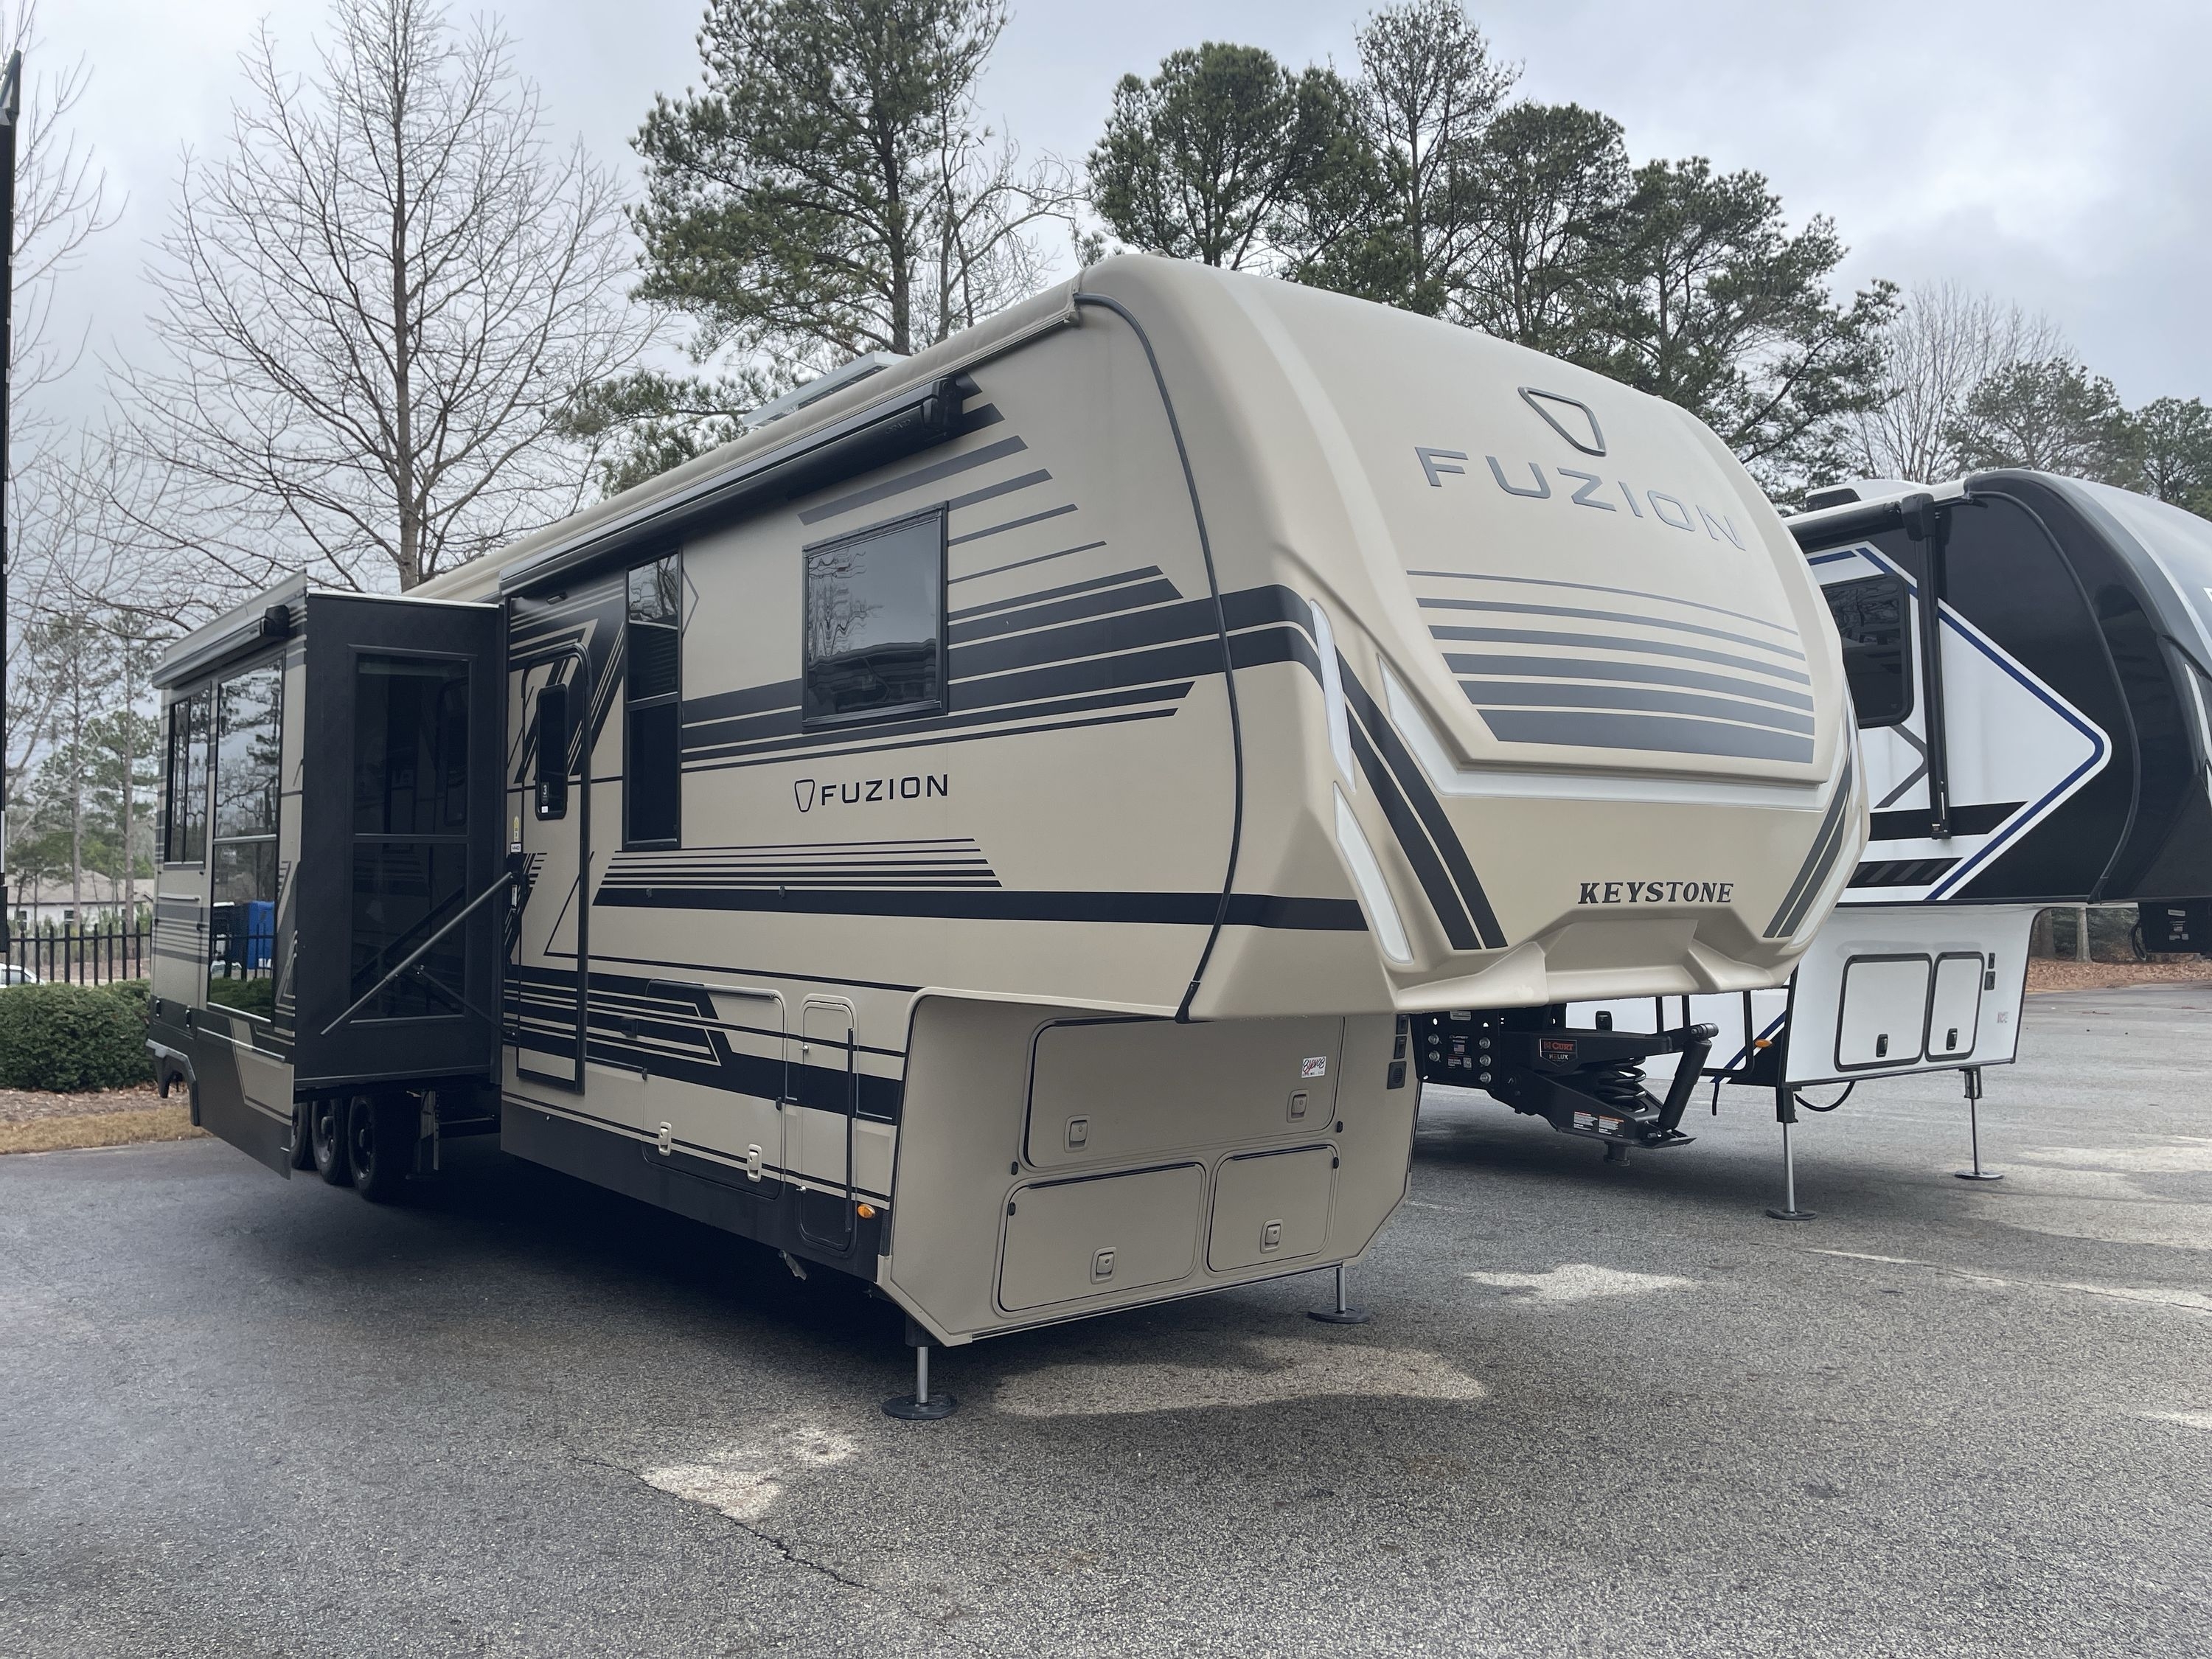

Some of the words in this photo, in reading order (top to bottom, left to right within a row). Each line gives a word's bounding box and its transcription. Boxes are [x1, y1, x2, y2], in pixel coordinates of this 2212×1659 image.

[1414, 446, 1746, 552] FUZION
[821, 773, 948, 806] FUZION
[1578, 881, 1734, 905] KEYSTONE
